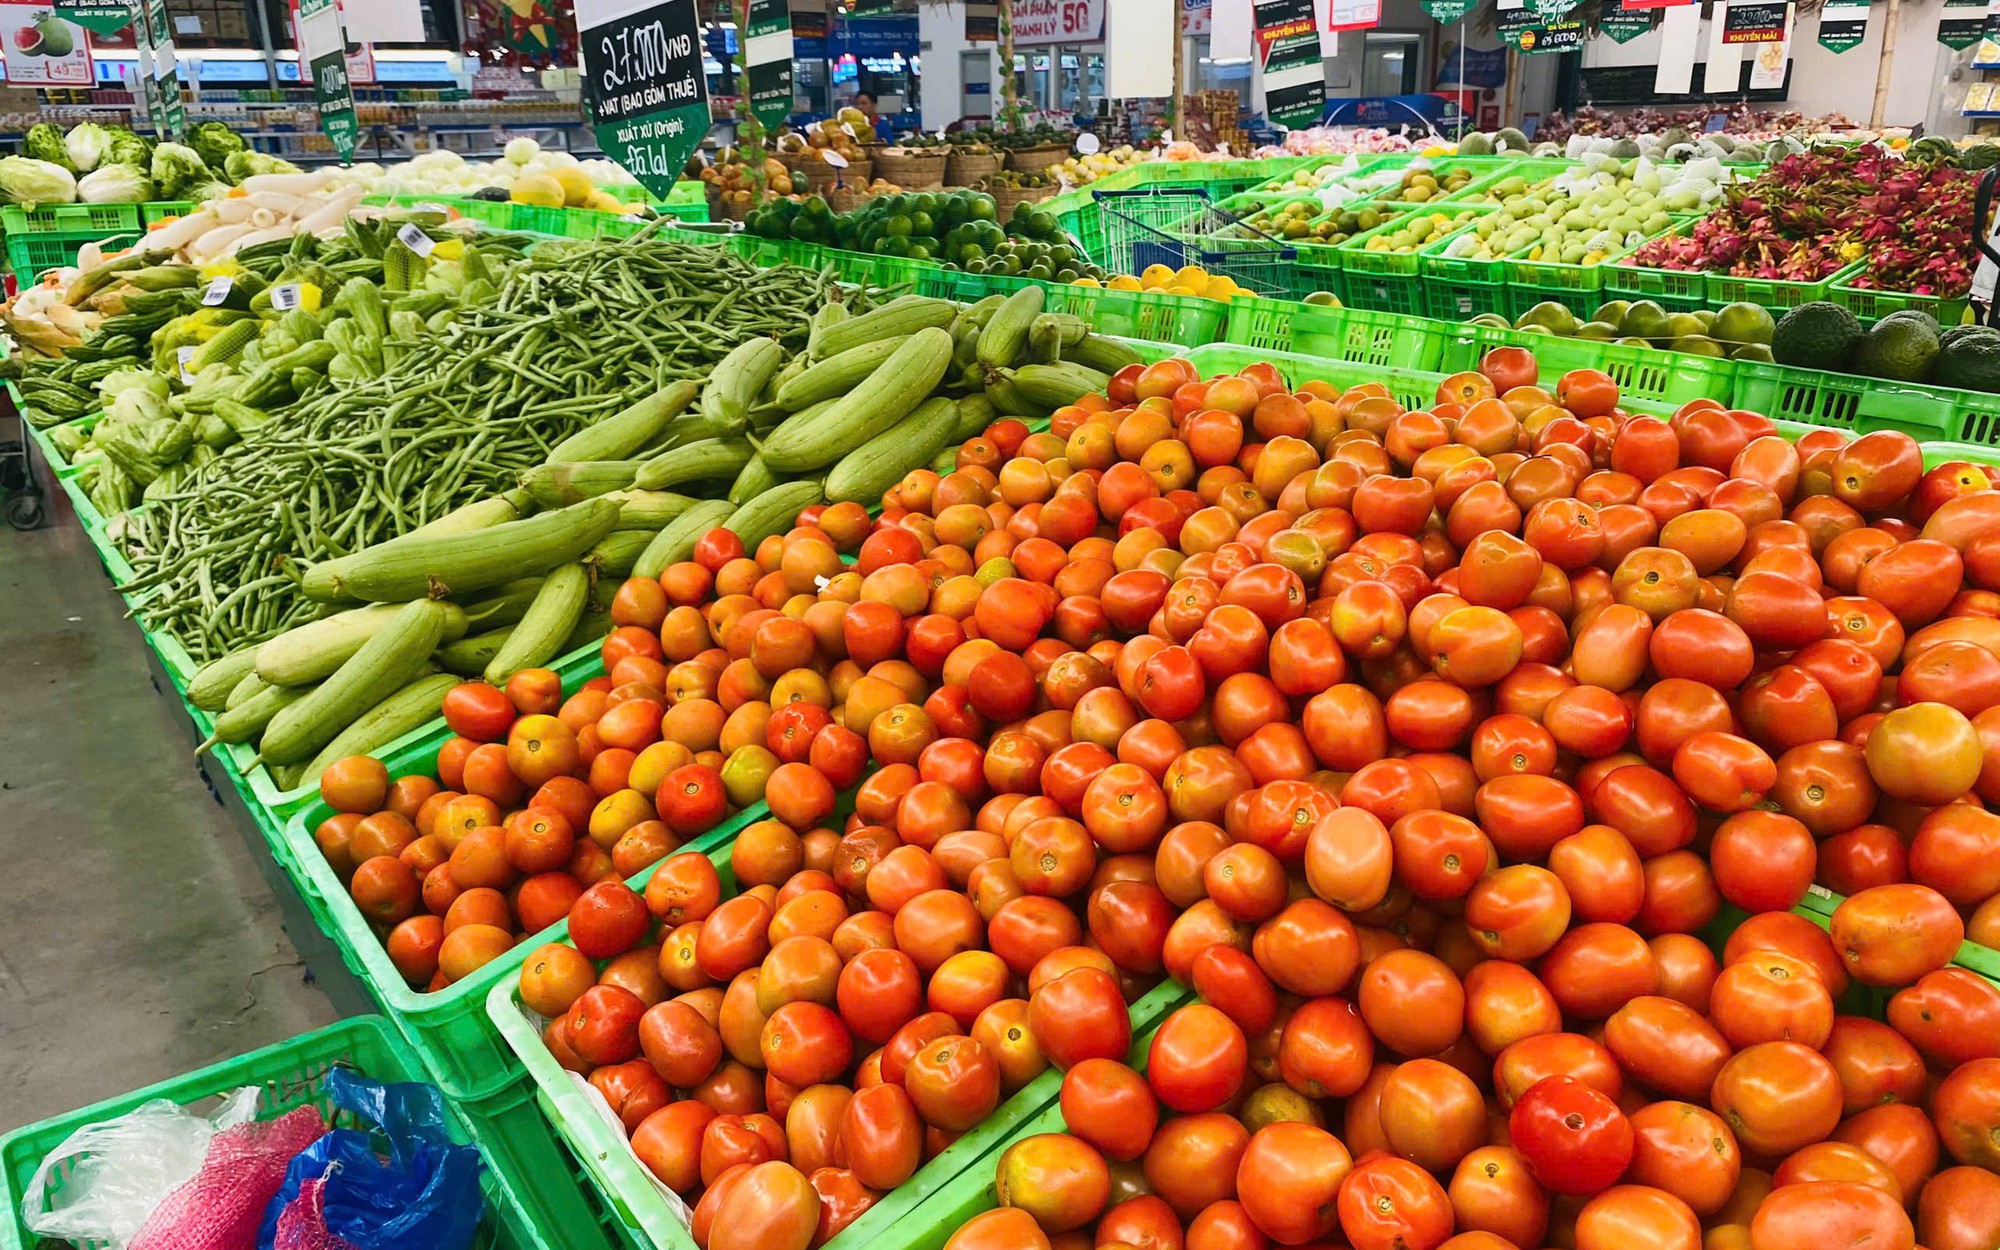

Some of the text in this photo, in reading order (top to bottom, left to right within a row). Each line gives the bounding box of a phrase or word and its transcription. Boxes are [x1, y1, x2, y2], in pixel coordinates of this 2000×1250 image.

[1729, 30, 1760, 42] KHUYẾN
[599, 69, 697, 117] +VAT (BAO GỒM THUẾ)
[616, 120, 638, 143] XUẤT
[639, 120, 652, 139] XỨ
